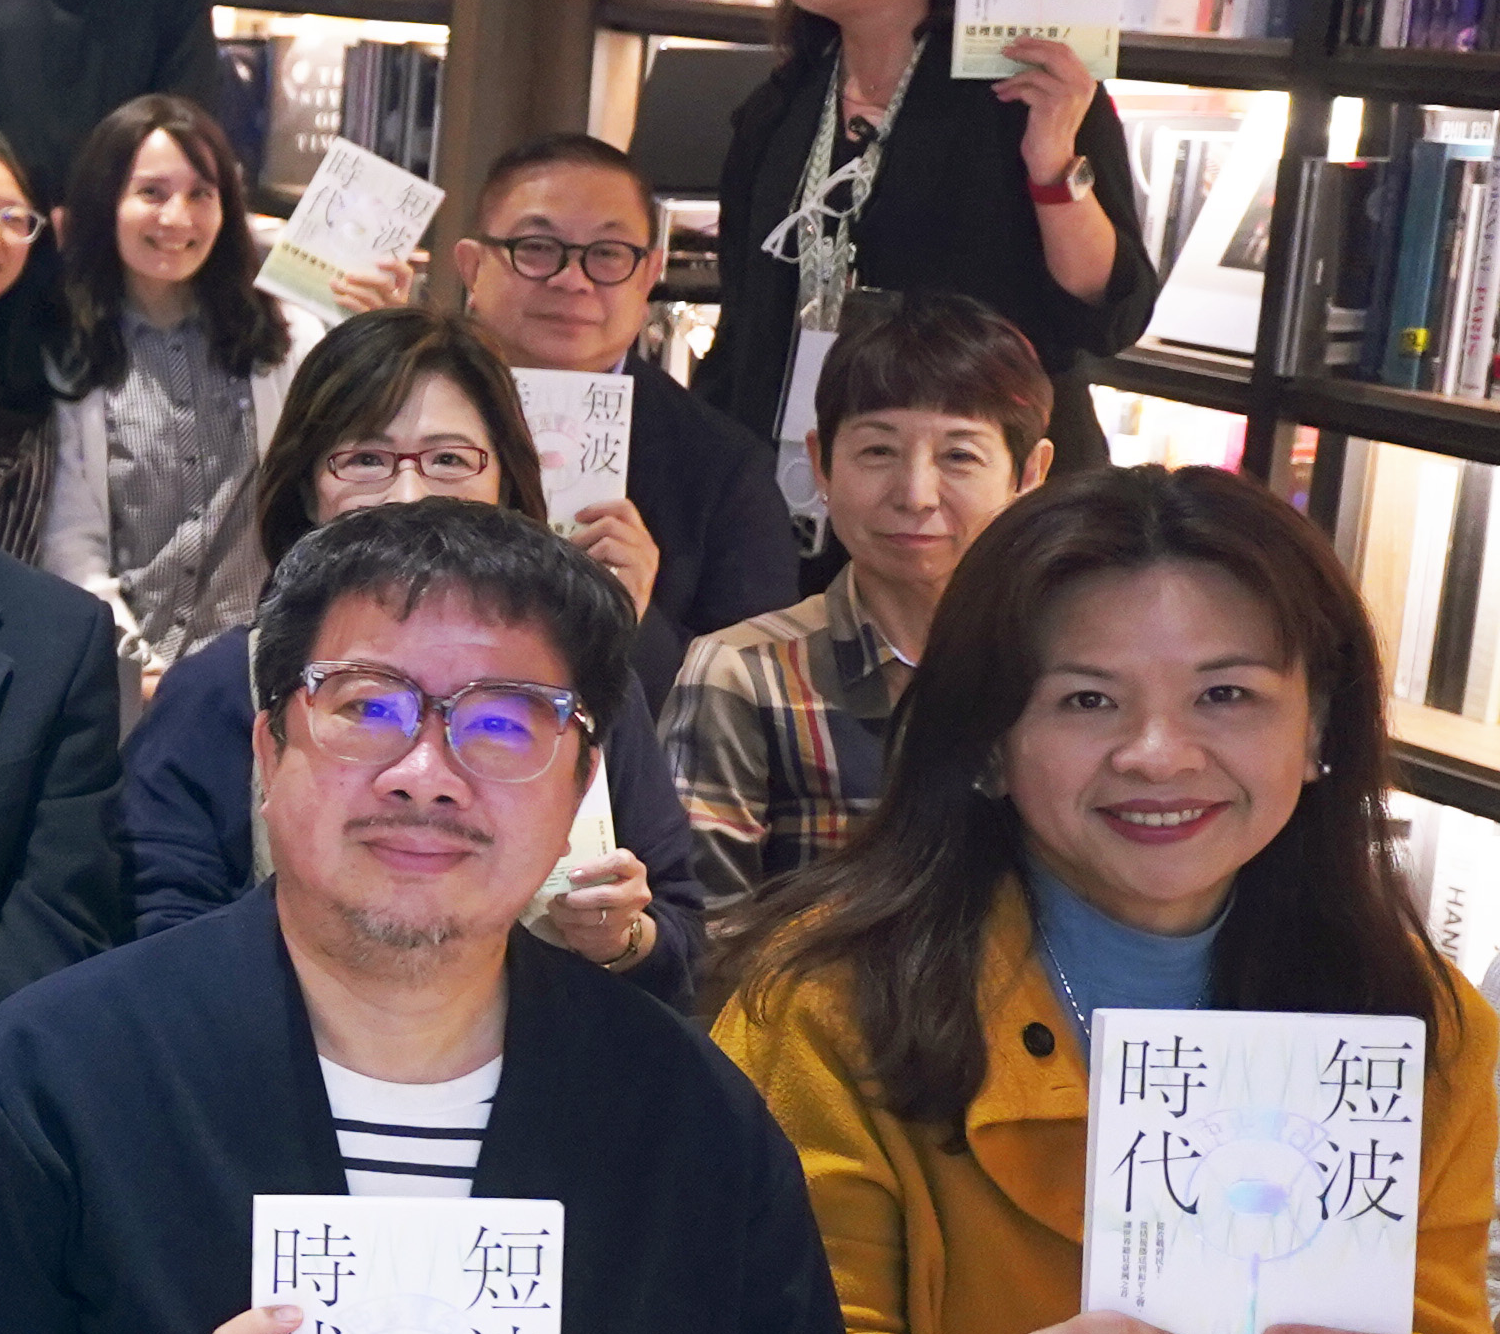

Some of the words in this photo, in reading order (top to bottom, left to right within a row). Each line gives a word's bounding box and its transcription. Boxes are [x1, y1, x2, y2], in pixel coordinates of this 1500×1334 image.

[307, 150, 364, 229] 時代
[372, 183, 432, 259] 短波
[580, 382, 628, 475] 短波
[1109, 1034, 1208, 1219] 時代
[1314, 1037, 1413, 1224] 短波
